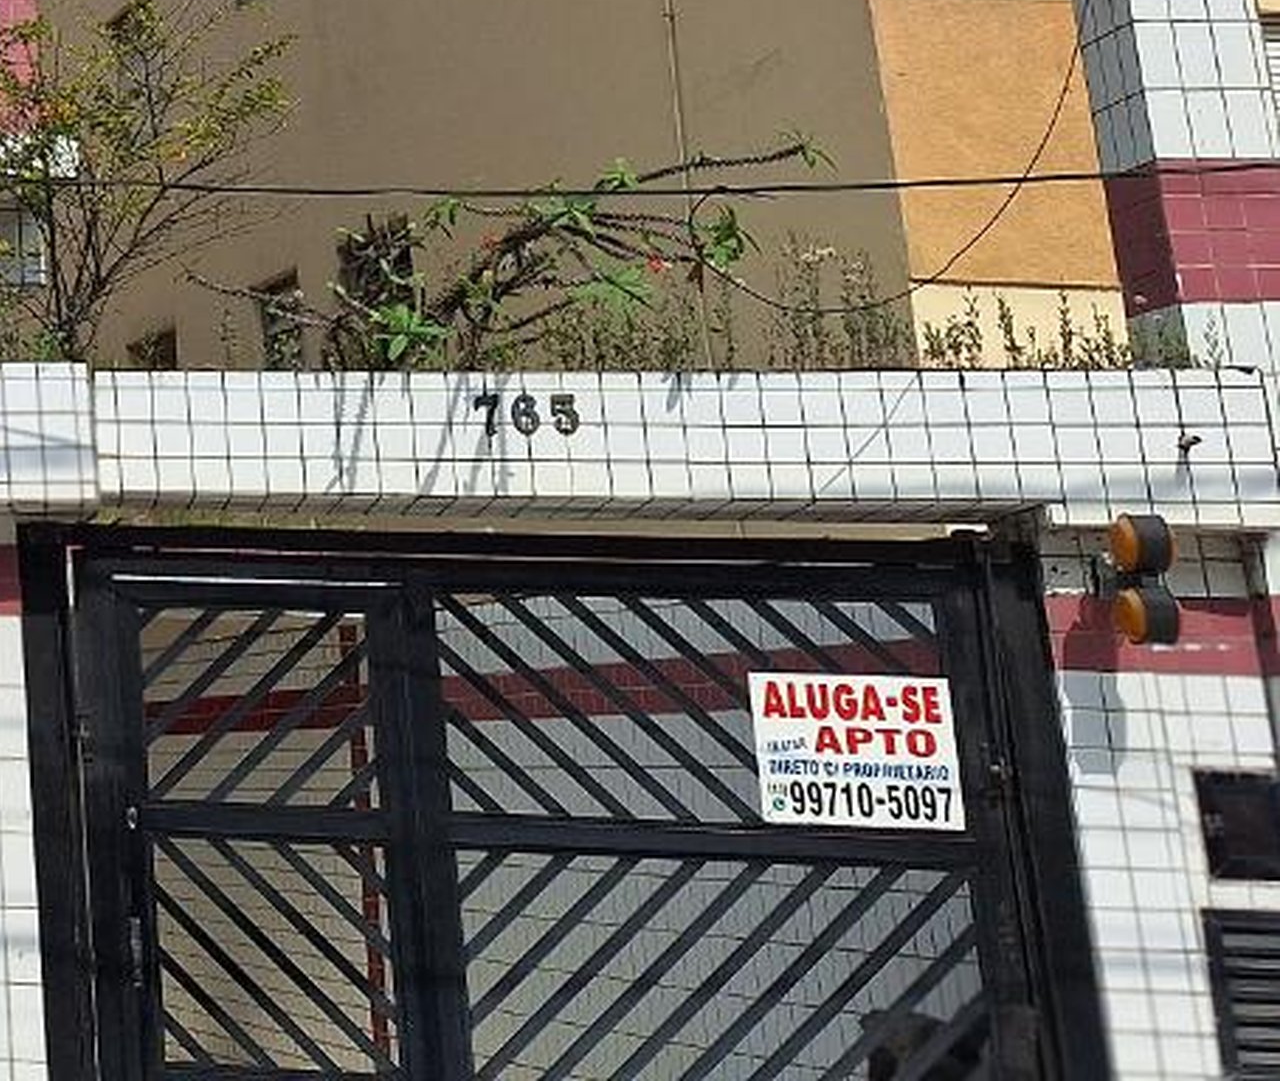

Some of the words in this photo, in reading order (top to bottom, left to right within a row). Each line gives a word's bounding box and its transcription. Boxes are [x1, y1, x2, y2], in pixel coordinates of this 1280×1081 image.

[473, 393, 580, 436] 765
[763, 680, 943, 724] ALUGA-SE
[814, 725, 938, 758] APTO
[767, 759, 818, 776] DIRETO
[790, 780, 952, 822] 99710-5097
